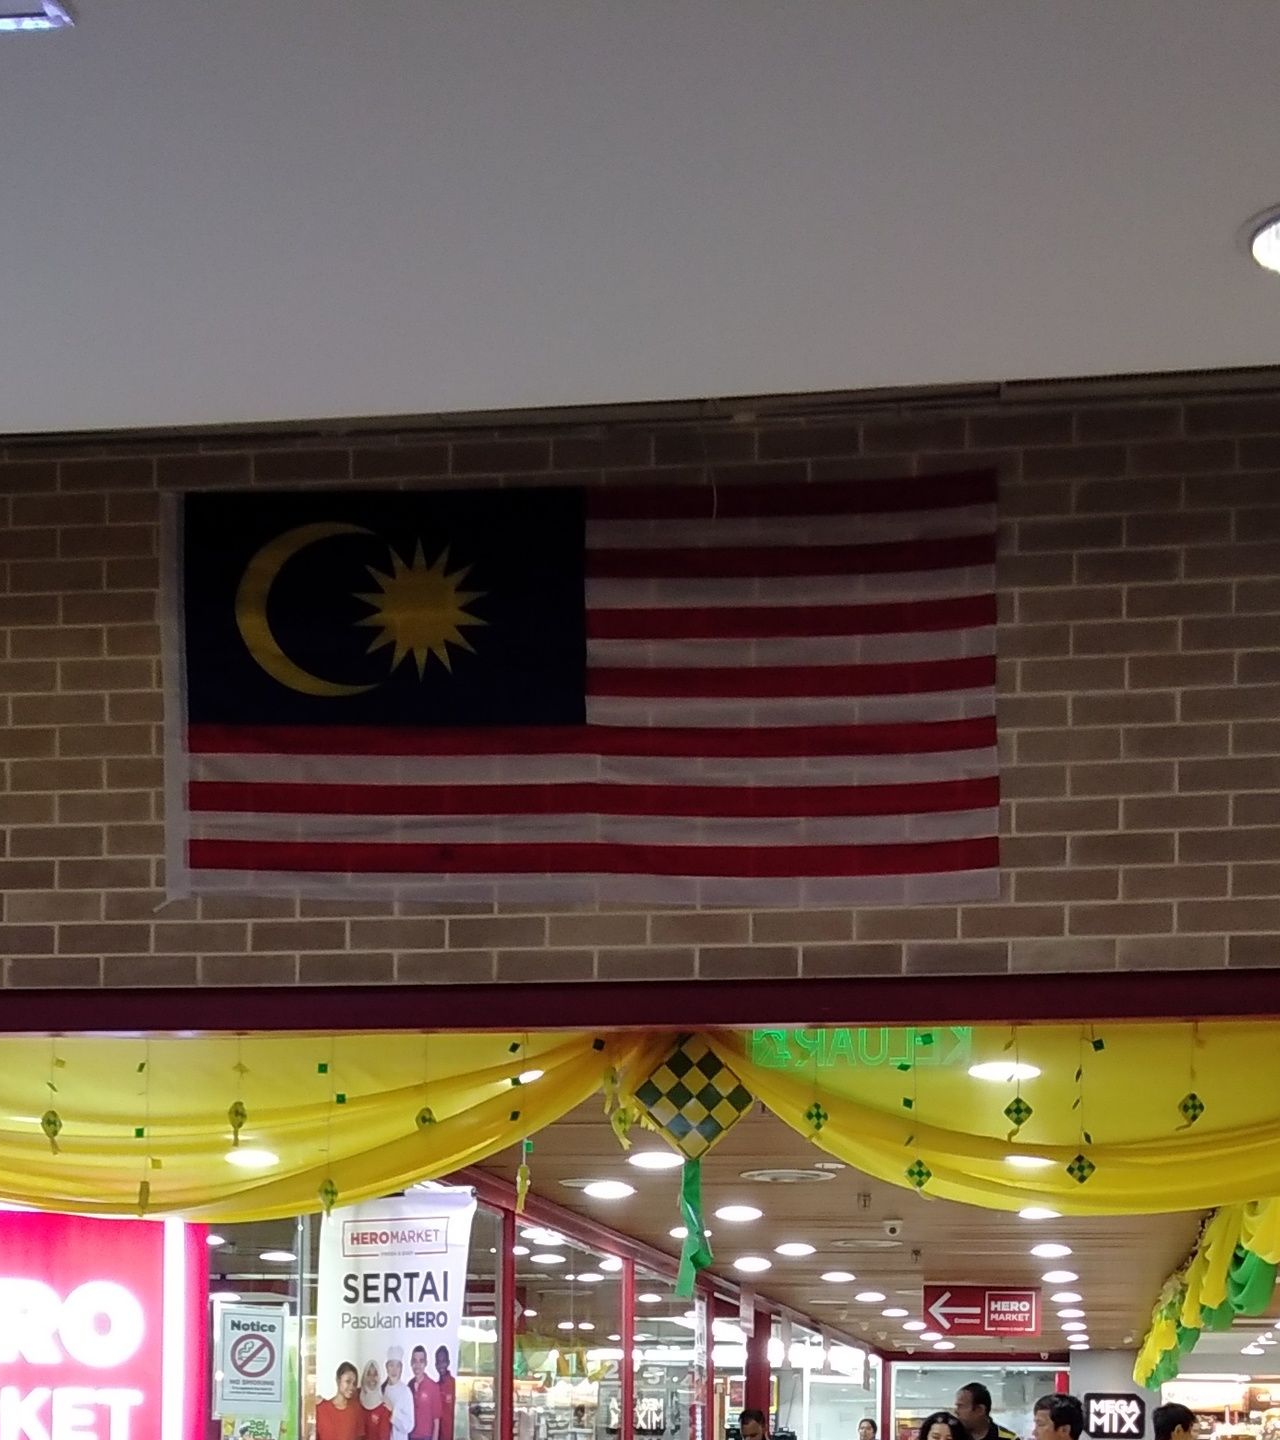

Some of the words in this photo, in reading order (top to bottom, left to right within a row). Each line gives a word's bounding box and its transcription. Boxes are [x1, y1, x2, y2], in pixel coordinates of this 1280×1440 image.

[350, 1229, 440, 1246] HEROMARKET
[342, 1271, 449, 1304] SERTAI
[989, 1301, 1031, 1312] HERO
[341, 1312, 402, 1330] Pasukan
[405, 1311, 448, 1329] HERO
[989, 1313, 1031, 1321] MARKET
[230, 1319, 277, 1333] Notice
[1089, 1399, 1141, 1414] MEGA
[1089, 1412, 1140, 1433] MIX
